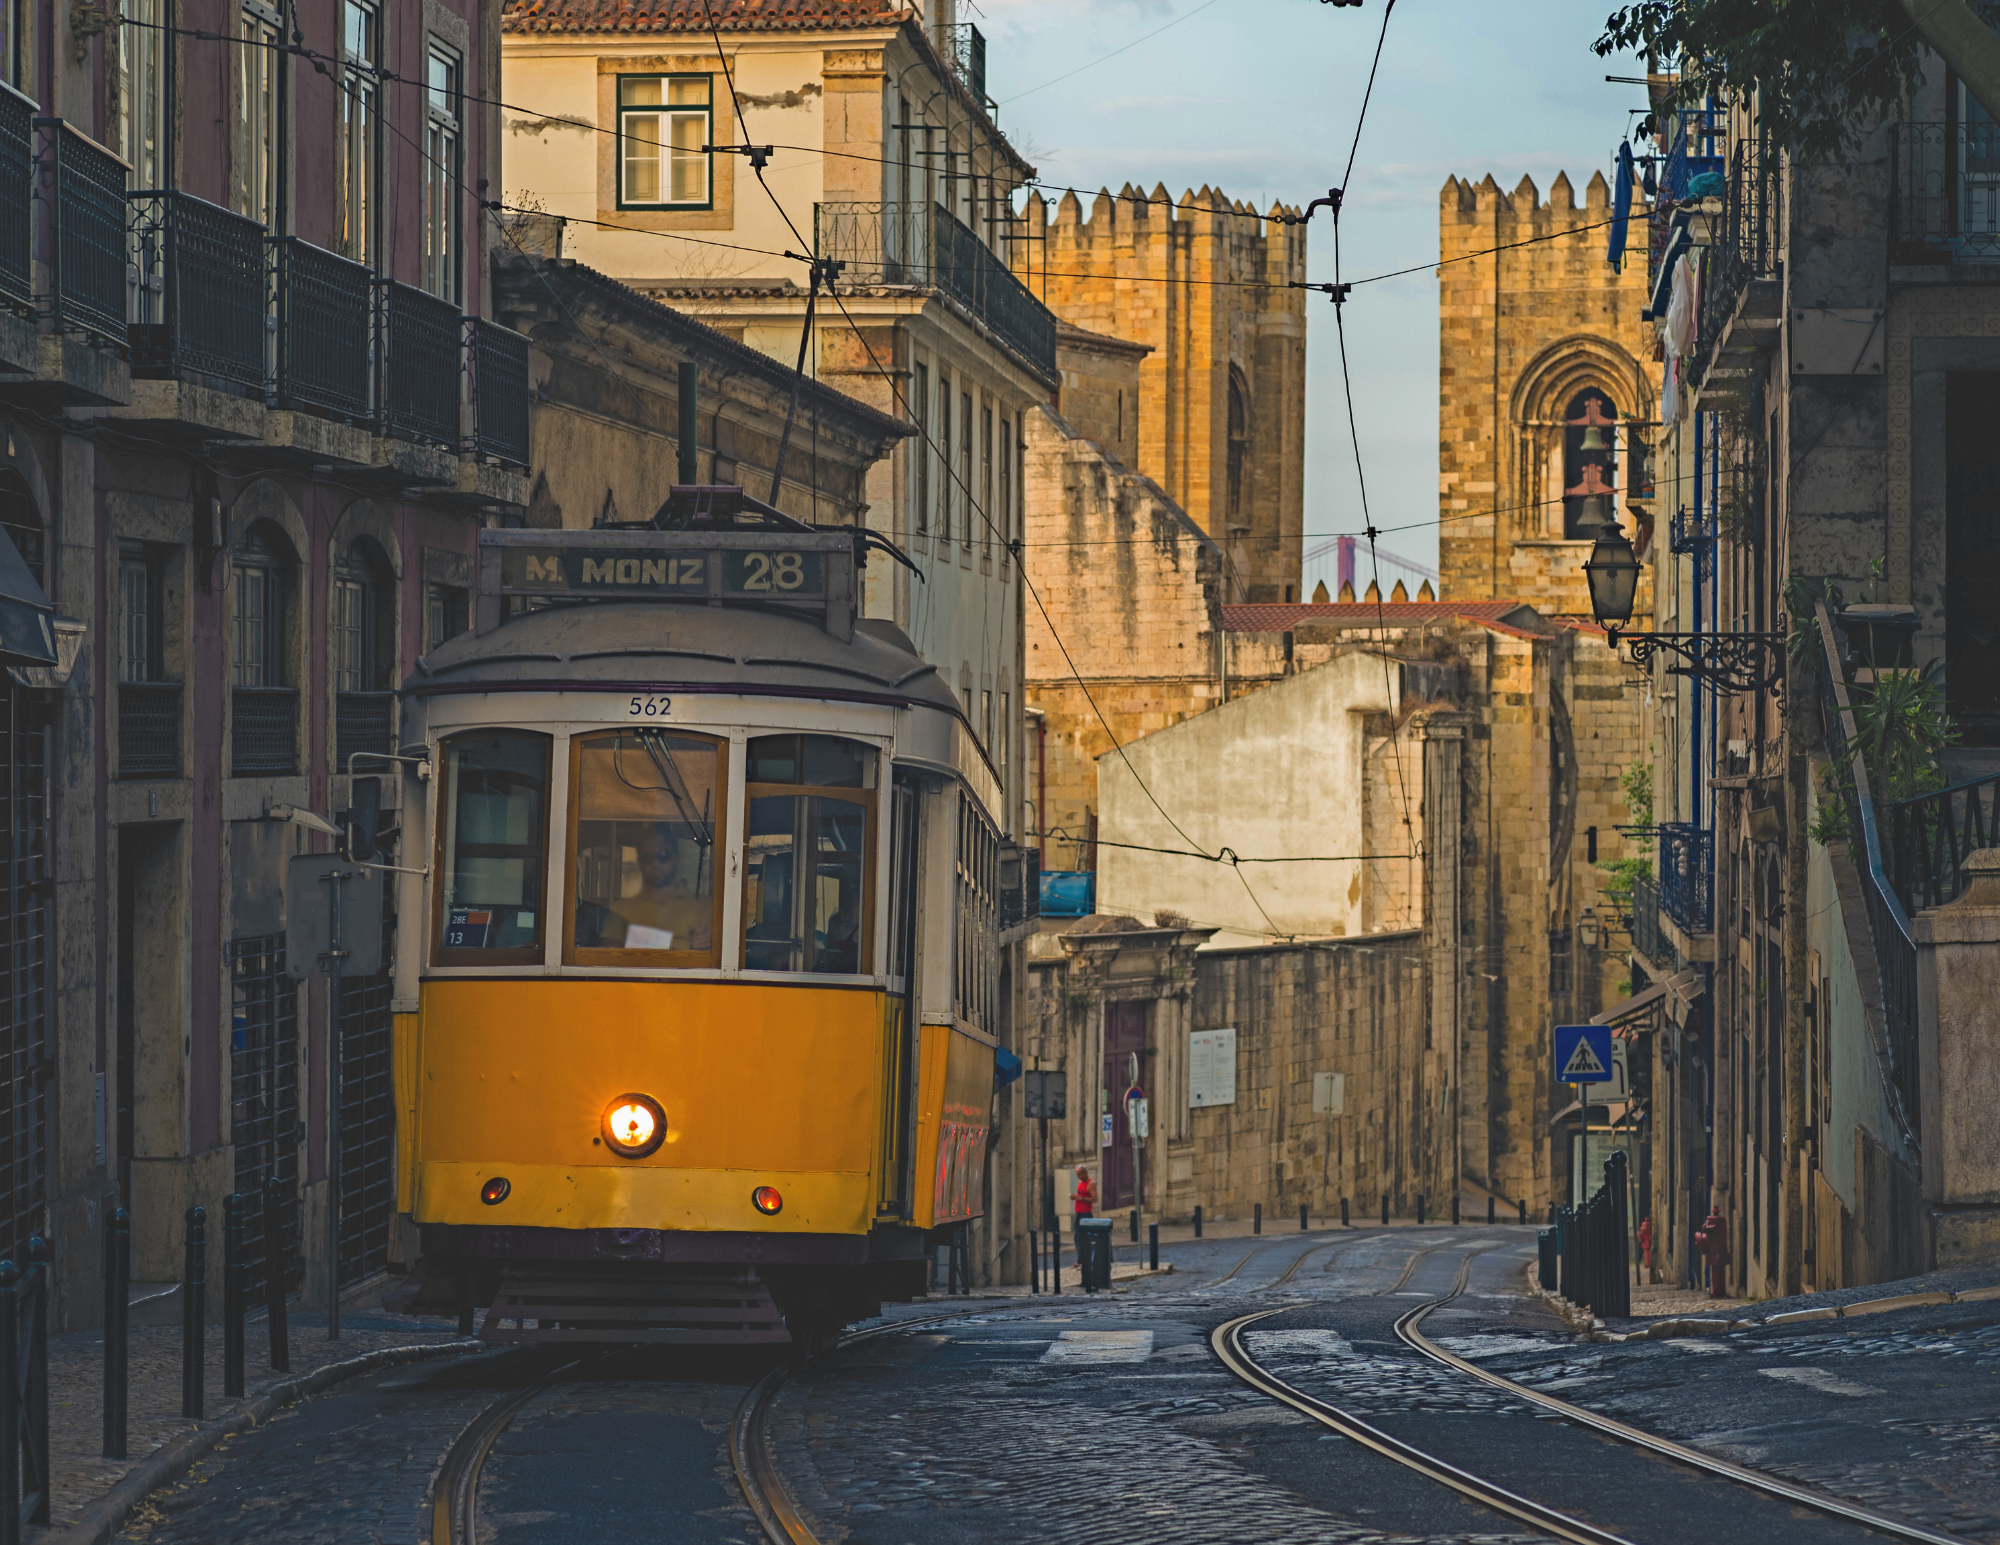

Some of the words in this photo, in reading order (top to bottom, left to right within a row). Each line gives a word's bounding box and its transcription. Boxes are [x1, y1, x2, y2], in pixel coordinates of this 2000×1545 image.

[525, 554, 563, 582] M.
[582, 558, 705, 585] MONIZ
[743, 552, 805, 591] 28
[629, 696, 671, 716] 562
[451, 915, 467, 925] 28E
[449, 932, 463, 945] 13
